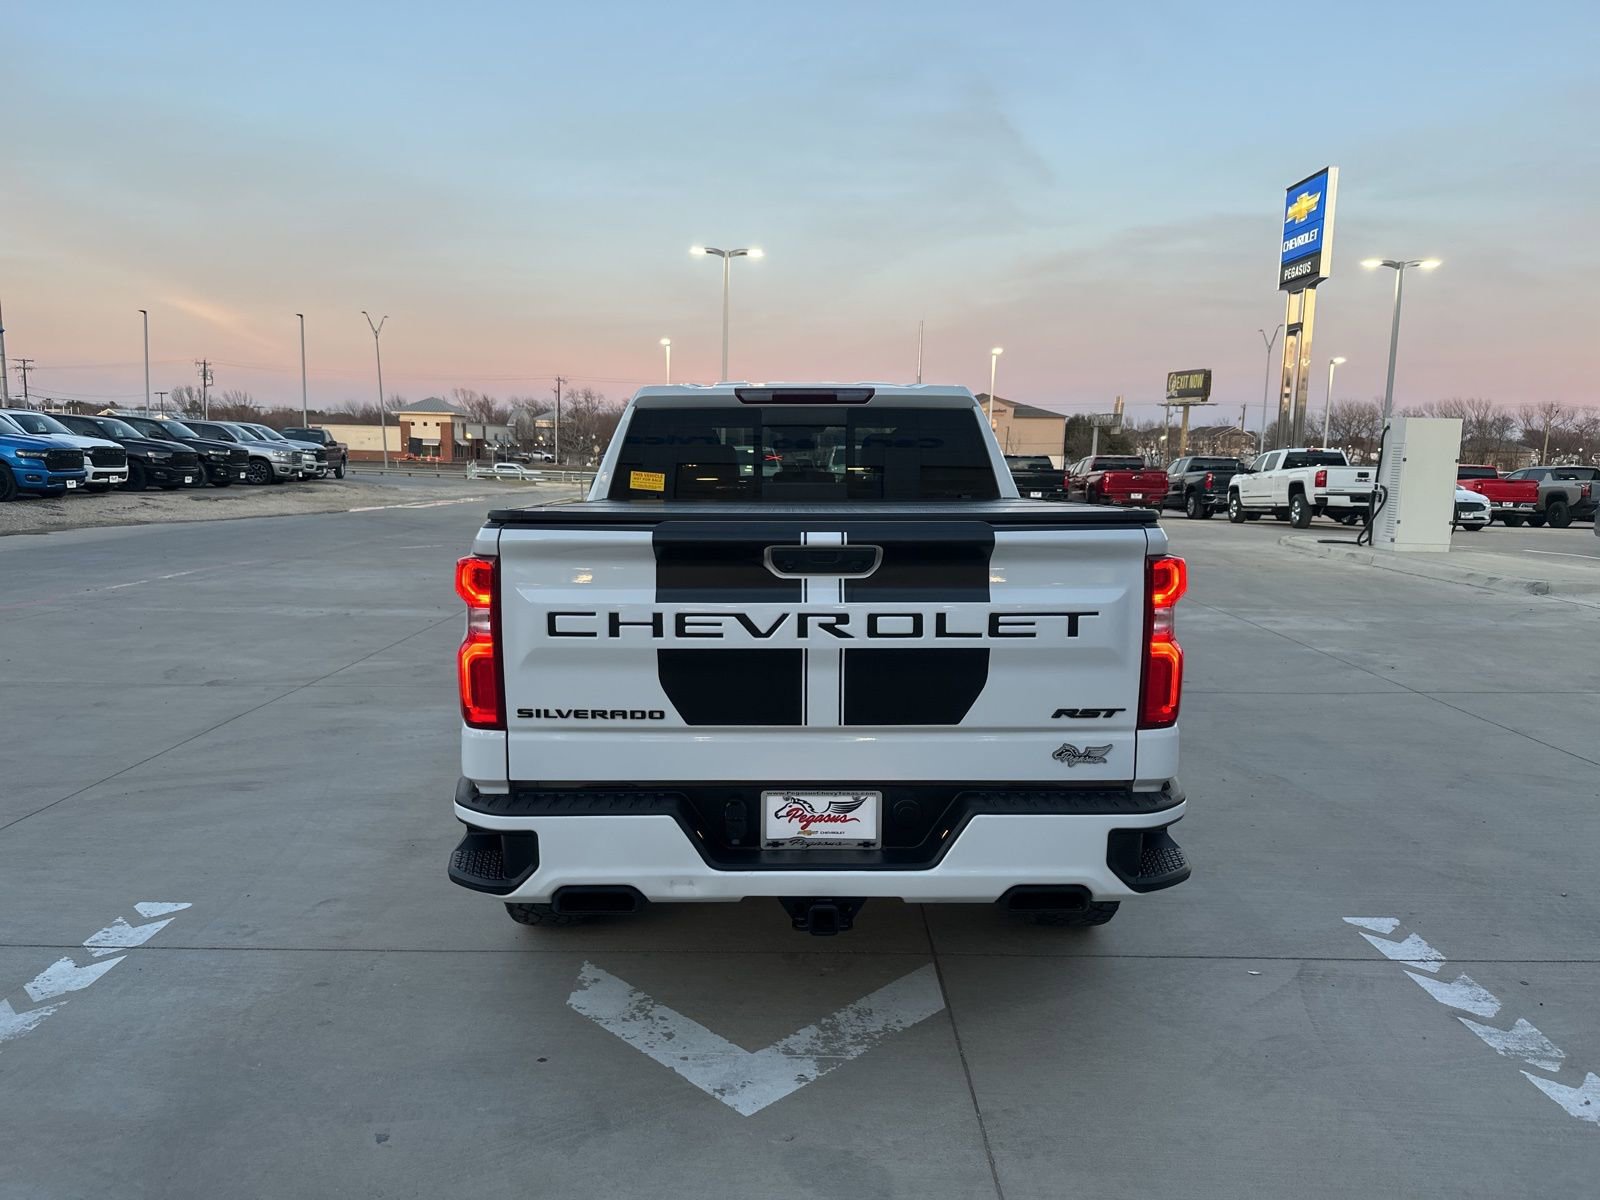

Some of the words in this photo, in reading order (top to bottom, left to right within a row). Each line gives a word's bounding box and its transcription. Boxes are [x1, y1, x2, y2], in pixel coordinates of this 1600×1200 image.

[1283, 228, 1319, 253] CHEVROLET
[1284, 261, 1312, 281] PEGASUS
[1176, 375, 1189, 389] EXIT
[1189, 374, 1204, 388] NOW
[547, 611, 1099, 638] CHEVROLET
[517, 708, 665, 720] SILVERADO
[1051, 708, 1126, 718] RST
[1061, 751, 1102, 767] Pegasus
[786, 807, 860, 830] Pegasus
